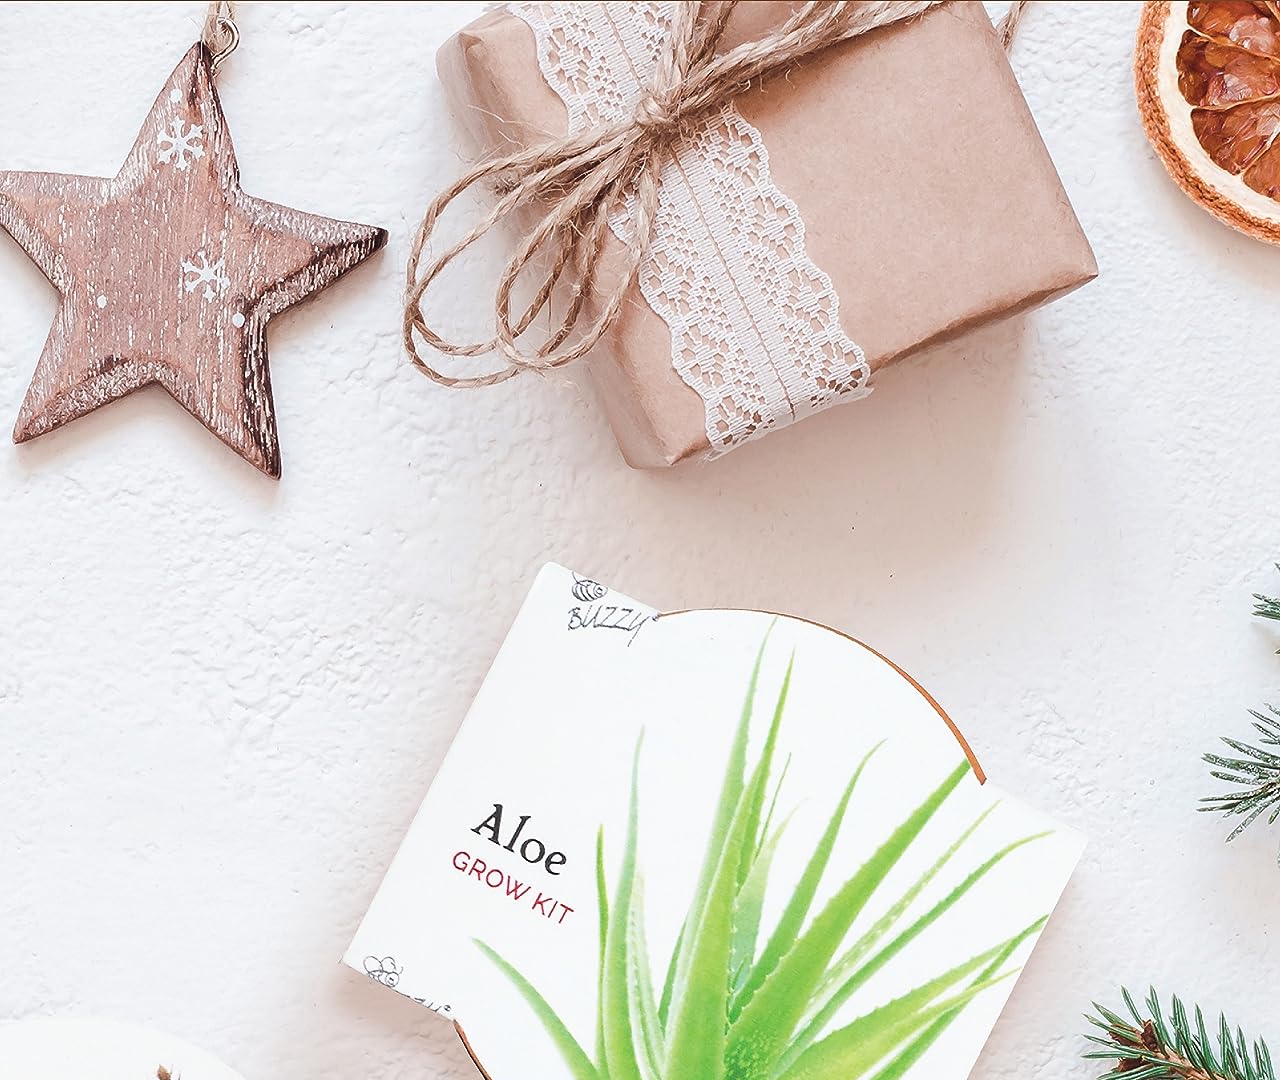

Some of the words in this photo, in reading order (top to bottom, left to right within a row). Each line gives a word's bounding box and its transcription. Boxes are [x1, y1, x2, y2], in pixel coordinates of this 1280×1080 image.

[470, 803, 568, 876] Aloe
[452, 851, 531, 901] GROW
[531, 892, 575, 924] KIT
